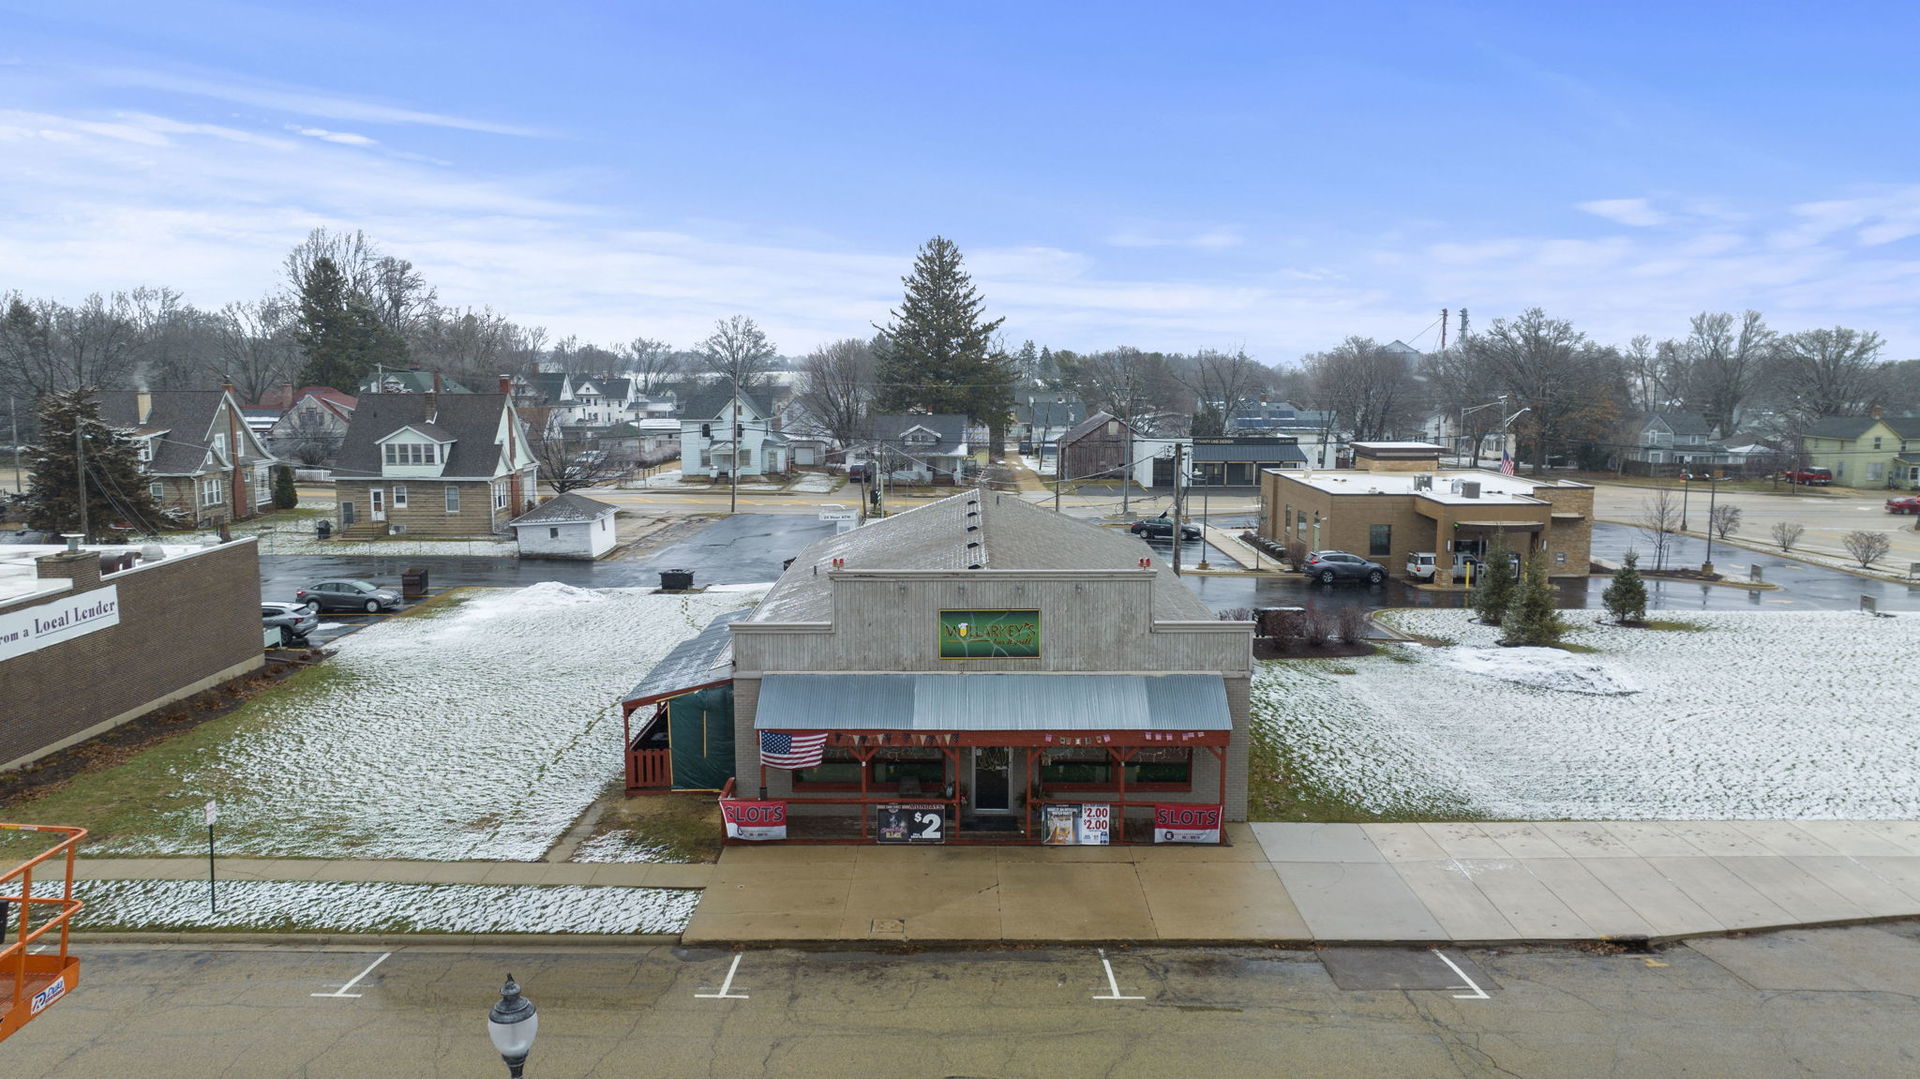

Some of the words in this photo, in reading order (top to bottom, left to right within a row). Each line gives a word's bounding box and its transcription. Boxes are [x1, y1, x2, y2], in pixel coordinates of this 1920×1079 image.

[23, 629, 29, 637] a
[34, 610, 69, 634] Local
[74, 601, 115, 622] Lender
[725, 806, 784, 822] SLOTS
[1083, 807, 1108, 818] $2.00
[1158, 809, 1217, 825] SLOTS
[914, 811, 941, 838] $2
[1083, 819, 1108, 830] $2.00
